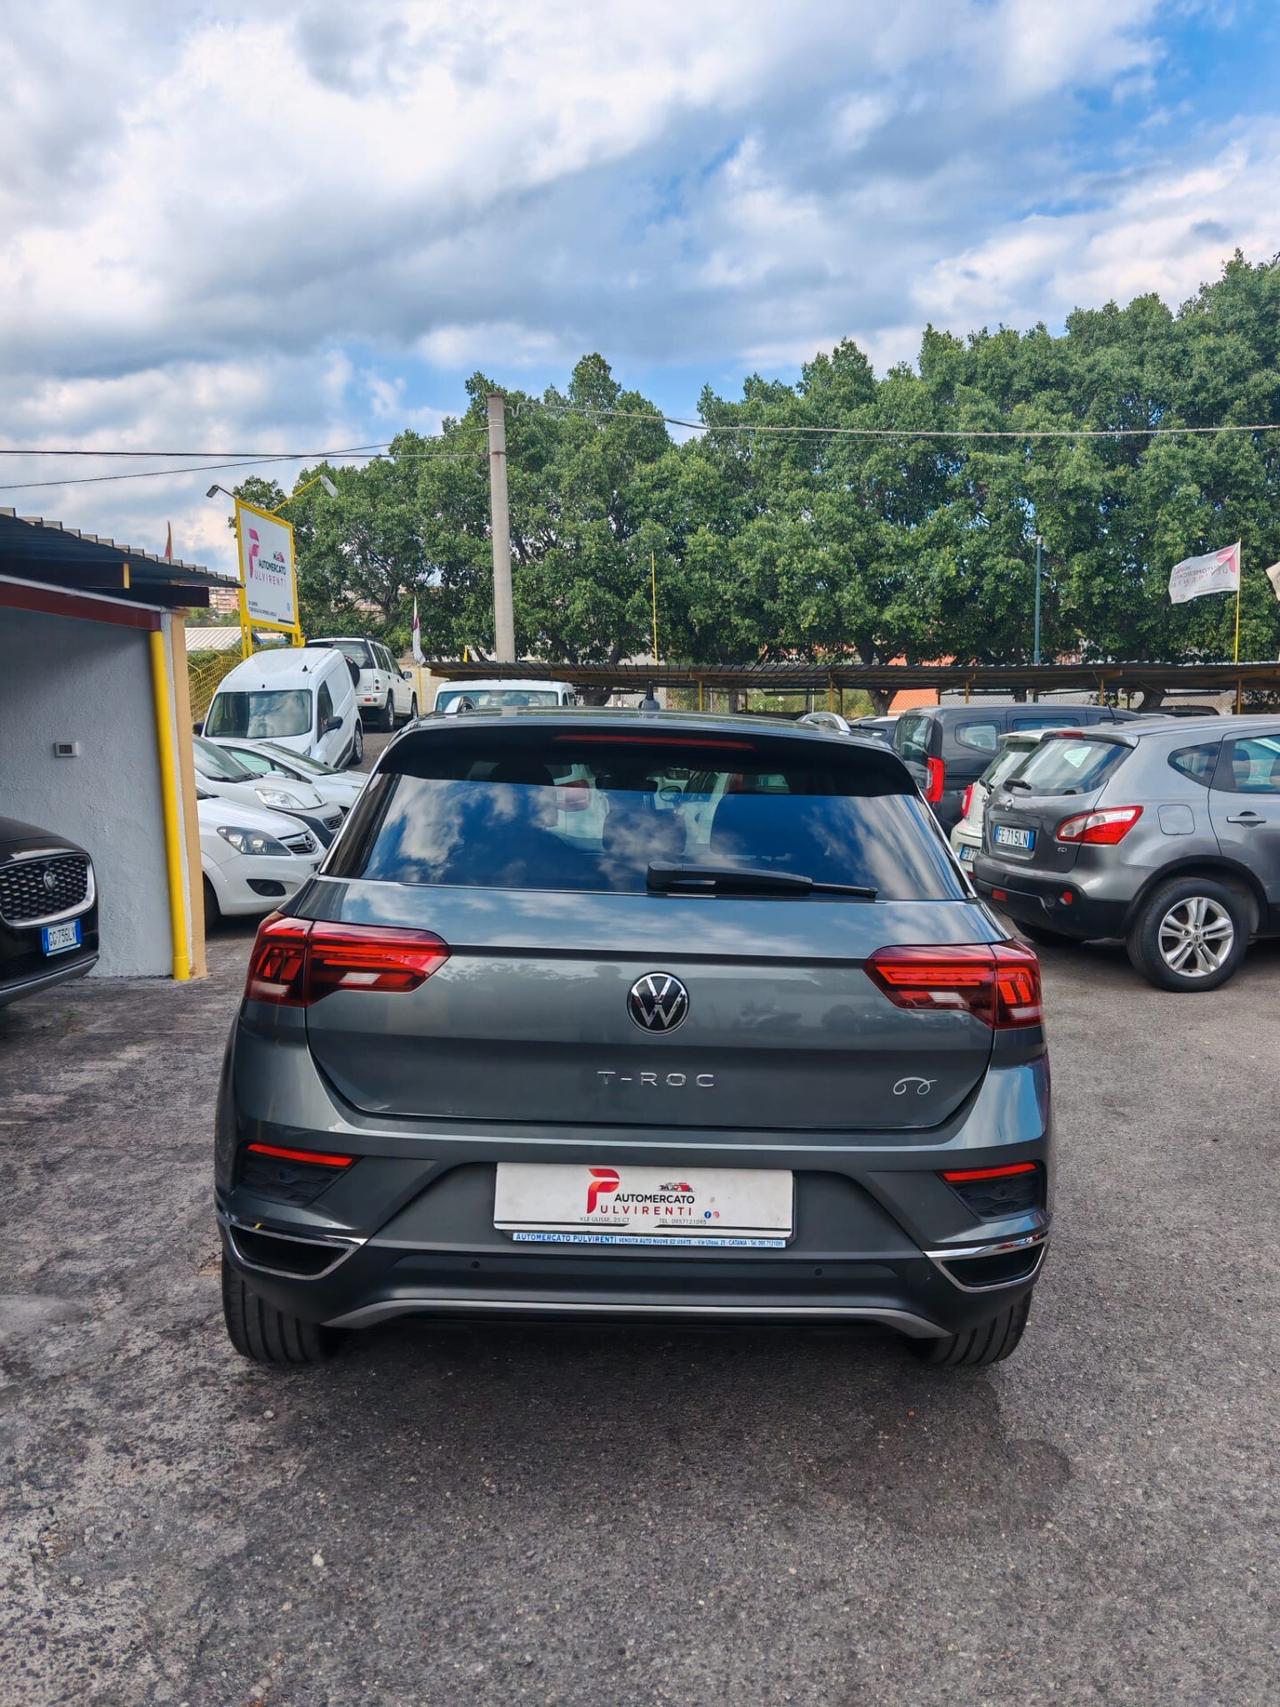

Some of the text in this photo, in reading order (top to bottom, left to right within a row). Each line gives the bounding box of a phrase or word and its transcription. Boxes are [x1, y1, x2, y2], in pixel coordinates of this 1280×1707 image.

[258, 560, 286, 575] AUTOMERCATO
[597, 1071, 714, 1087] T-ROC
[614, 1194, 695, 1204] AUTOMERCATO
[516, 1234, 571, 1242] AUTOMERCATO
[573, 1236, 617, 1244] PULVIRENTI
